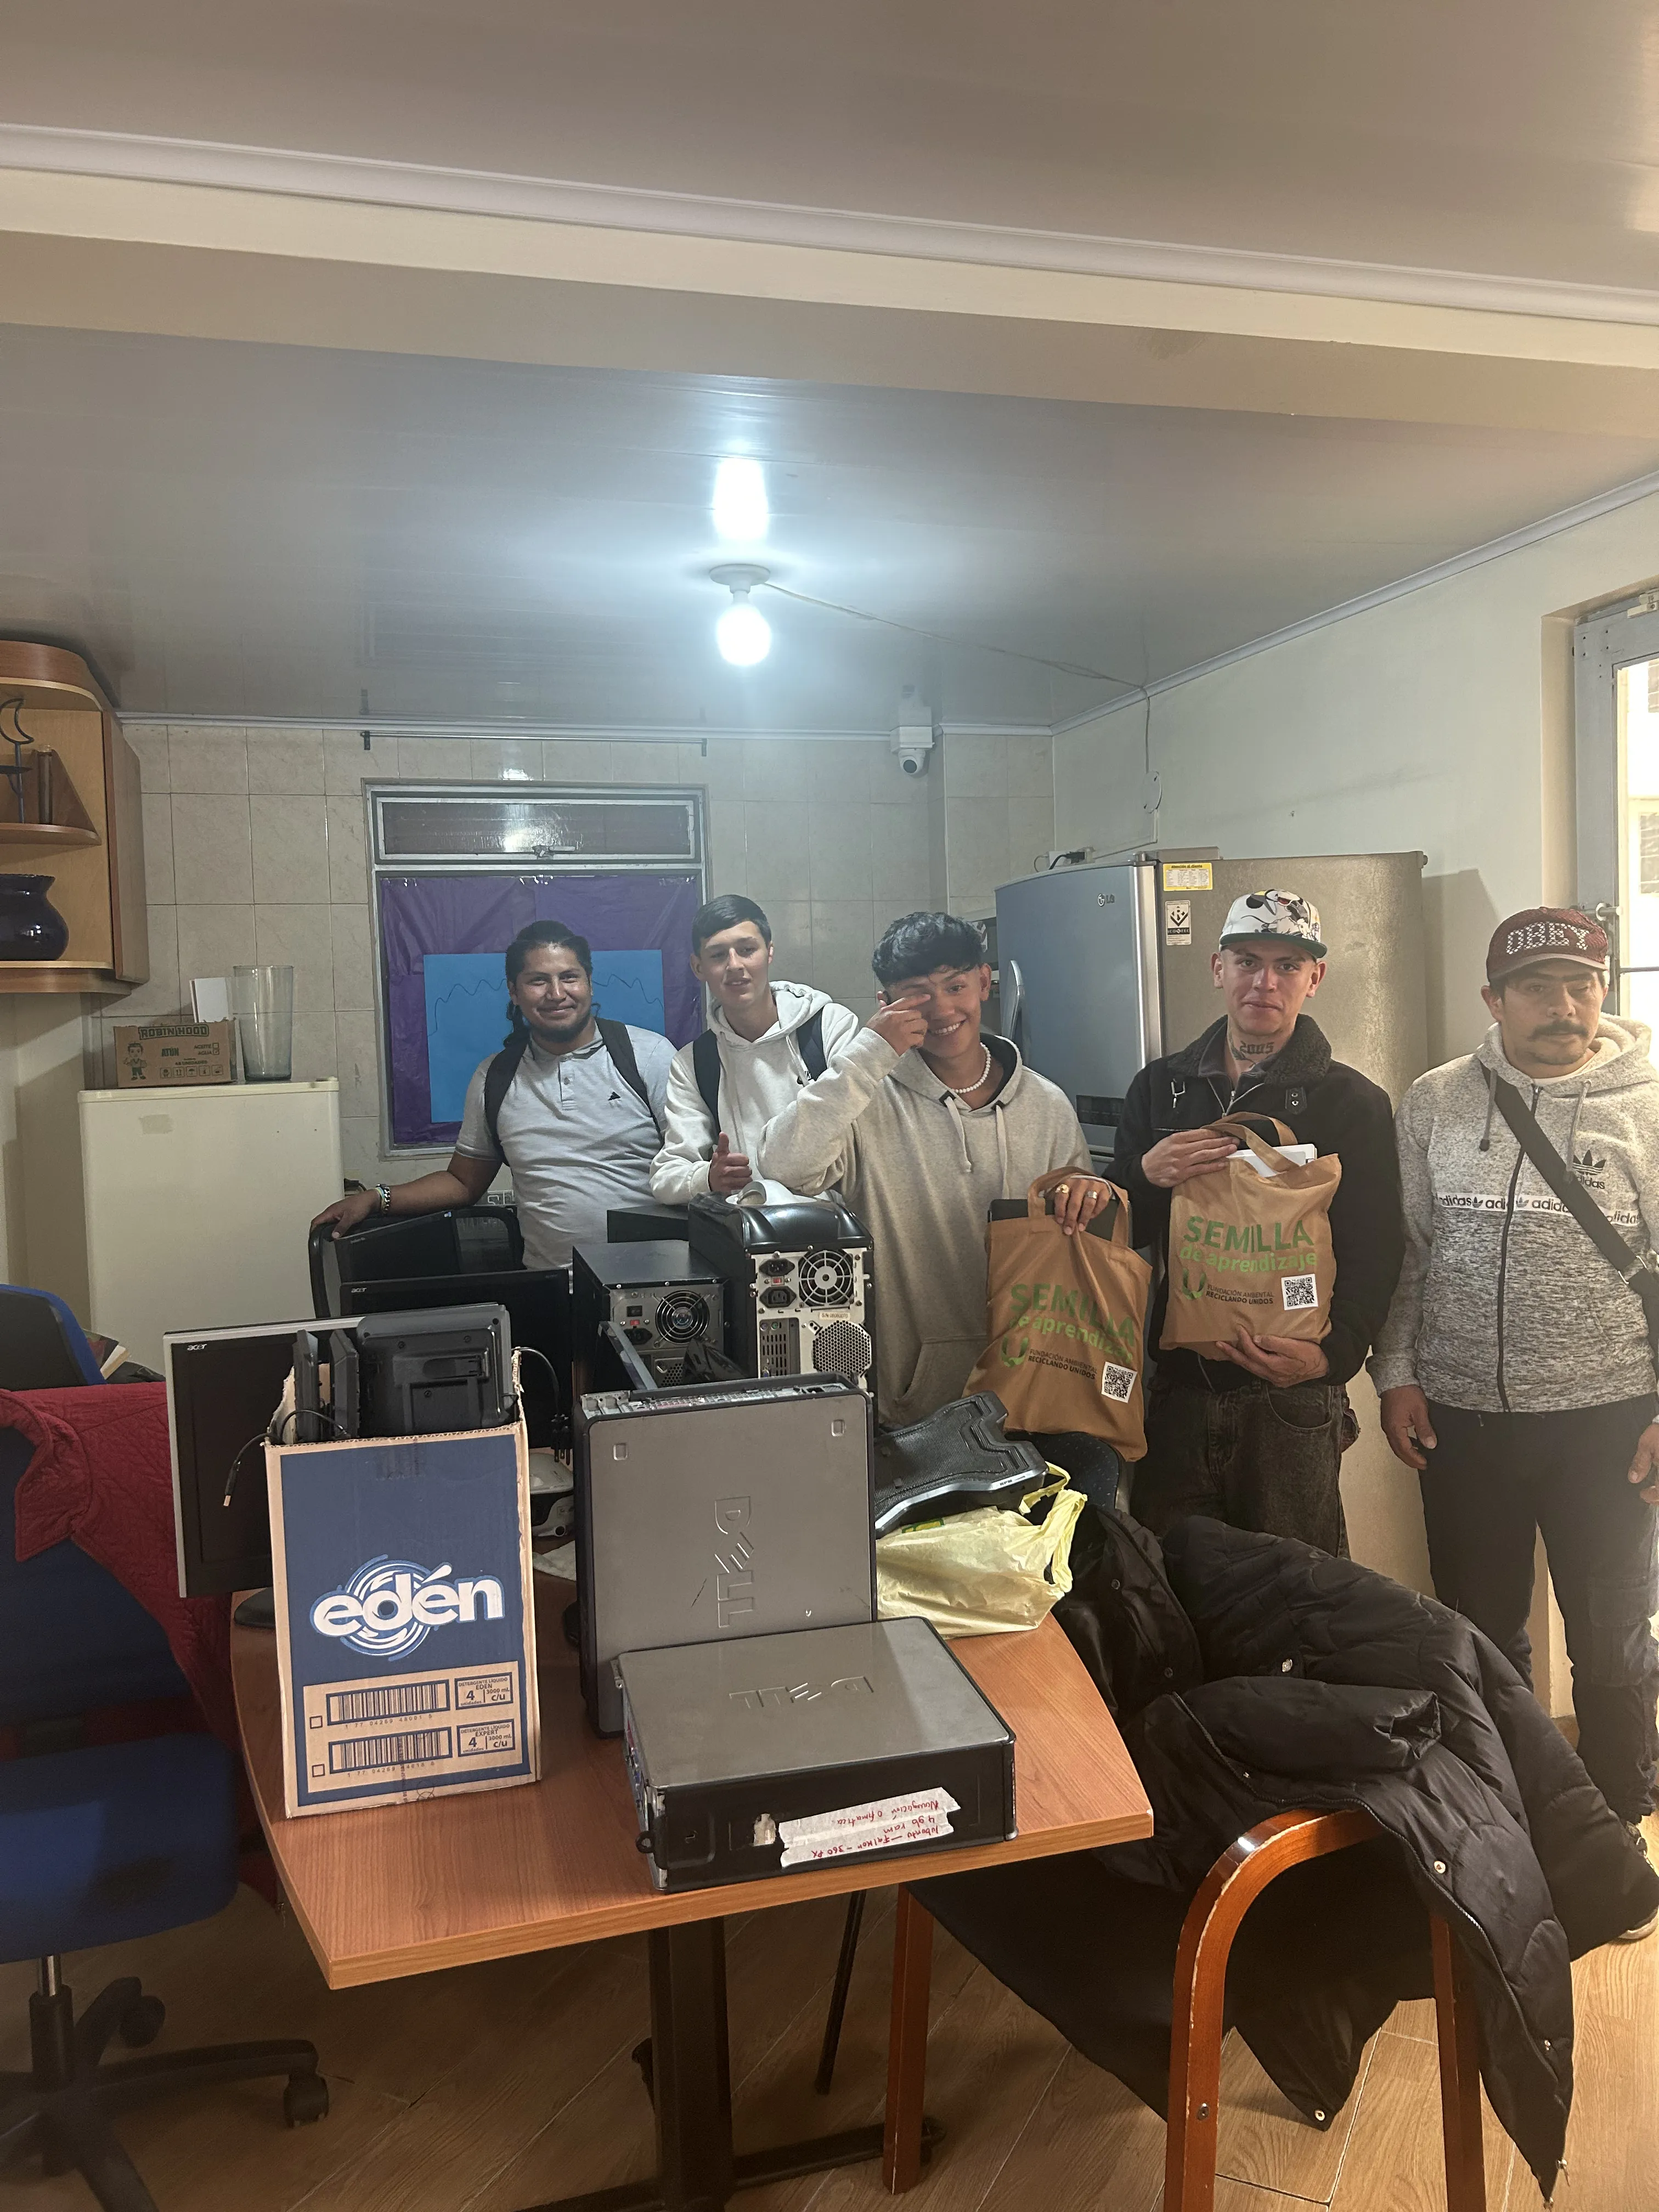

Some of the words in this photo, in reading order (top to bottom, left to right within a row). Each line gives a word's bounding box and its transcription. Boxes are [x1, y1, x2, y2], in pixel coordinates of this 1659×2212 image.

[1506, 921, 1589, 955] OBEY
[140, 1026, 176, 1039] ROBIN
[177, 1025, 208, 1036] HOOD
[1240, 1040, 1274, 1054] 2005
[1183, 1215, 1314, 1254] SEMILLA
[1180, 1244, 1203, 1261] de
[1206, 1250, 1317, 1273] aprendizaje
[1206, 1290, 1248, 1304] RECICLANDO
[1207, 1284, 1242, 1297] FUNDACIÓN
[1029, 1348, 1064, 1363] FUNDACIÓN
[1028, 1355, 1069, 1370] RECICLANDO
[1069, 1366, 1096, 1380] UNIDOS
[714, 1496, 754, 1628] DELL
[312, 1563, 504, 1637] edén
[458, 1679, 488, 1687] DETERGENTE
[466, 1690, 475, 1700] 4
[729, 1676, 874, 1709] DELL
[468, 1737, 477, 1747] 4
[883, 1822, 906, 1833] ram
[827, 1846, 844, 1855] 360
